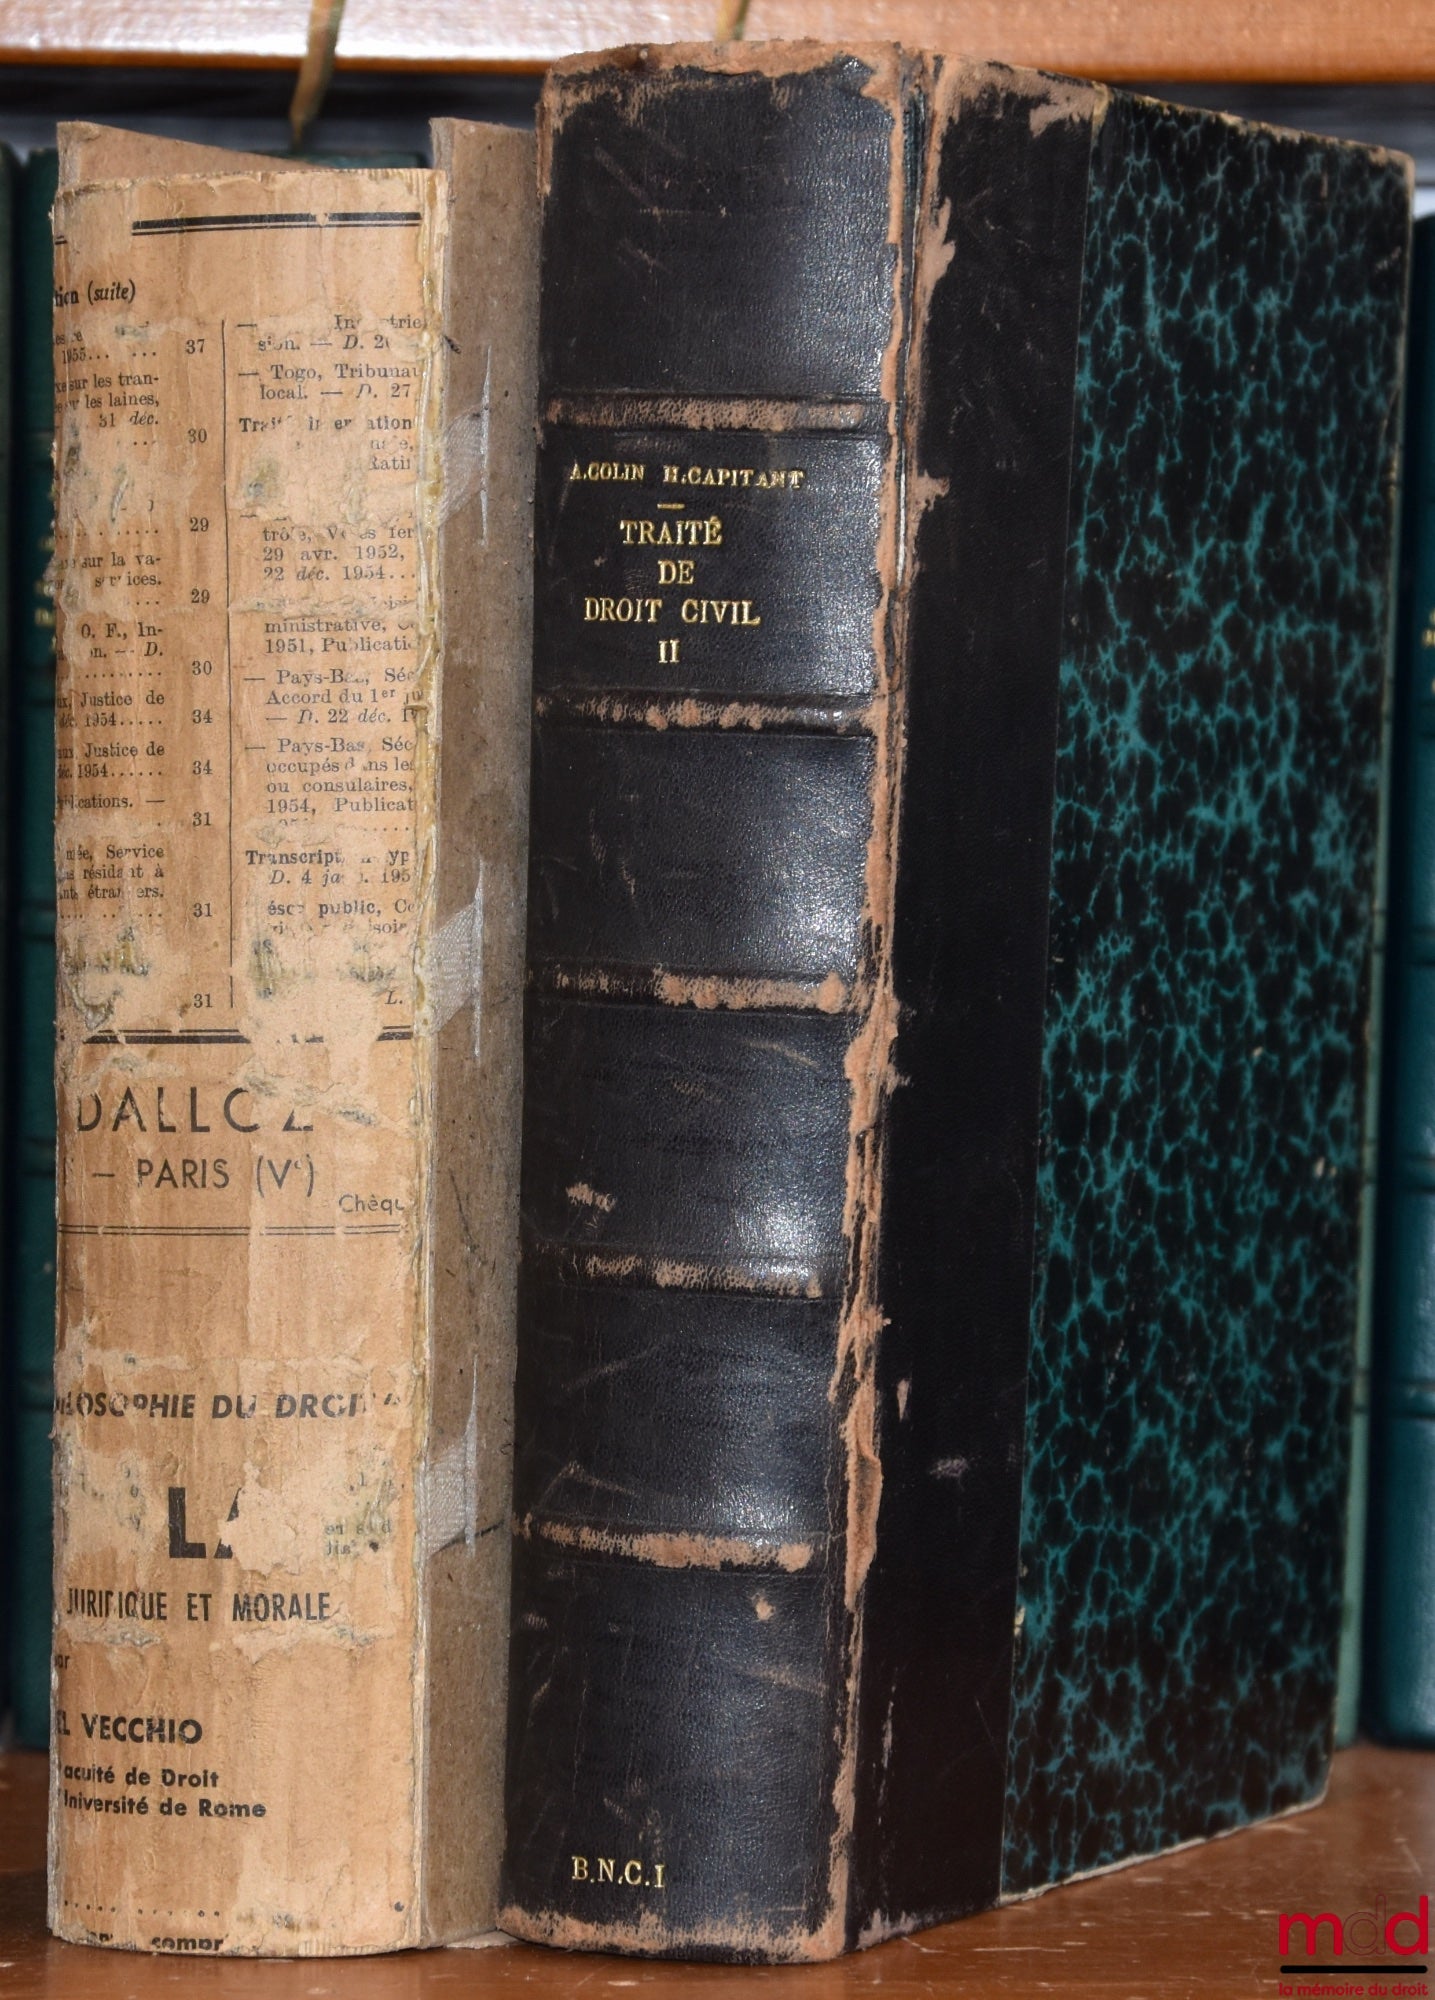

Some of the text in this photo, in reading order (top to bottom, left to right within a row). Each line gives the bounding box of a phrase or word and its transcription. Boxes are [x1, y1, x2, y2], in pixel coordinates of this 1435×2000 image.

[87, 278, 136, 306] (suite)
[184, 339, 206, 355] 37
[342, 334, 364, 350] D.
[92, 374, 112, 388] les
[118, 371, 160, 386] tran-
[270, 364, 322, 382] Togo,
[260, 384, 308, 400] local.
[391, 383, 411, 398] 27
[85, 394, 102, 408] les
[108, 393, 160, 408] laines,
[128, 410, 159, 426] déc.
[187, 428, 208, 444] 30
[570, 462, 646, 481] A.COLIN
[190, 516, 210, 532] 29
[82, 556, 104, 568] sur
[111, 552, 126, 566] la
[135, 554, 161, 566] va-
[262, 544, 404, 562] 29 avr. 1952,
[264, 566, 284, 581] 22
[296, 566, 330, 581] déc.
[658, 560, 695, 584] DE
[190, 588, 210, 604] 29
[584, 597, 762, 626] DROIT CIVIL
[264, 618, 386, 634] ministrative,
[144, 641, 164, 657] D.
[265, 638, 314, 654] 1951,
[658, 639, 681, 664] II
[191, 660, 212, 676] 30
[80, 691, 133, 708] Justice
[146, 690, 165, 705] de
[266, 688, 330, 705] Accord
[338, 688, 363, 704] du
[192, 708, 213, 725] 34
[328, 708, 349, 724] 22
[358, 708, 392, 724] déc.
[84, 742, 138, 758] Justice
[146, 741, 165, 756] de
[192, 760, 213, 776] 34
[266, 758, 340, 776] occupés
[266, 777, 413, 794] ou consulaires,
[266, 797, 414, 816] 1954, Publicat
[192, 812, 212, 827] 31
[106, 844, 164, 860] Service
[154, 864, 164, 878] à
[269, 869, 291, 884] D.
[301, 869, 312, 884] 4
[192, 902, 212, 918] 31
[319, 900, 382, 918] public,
[193, 994, 213, 1009] 31
[137, 1158, 230, 1190] PARIS
[211, 1394, 257, 1420] DU
[186, 1592, 213, 1622] ET
[232, 1590, 331, 1622] MORALE
[81, 1712, 204, 1746] VECCHIO
[125, 1766, 151, 1786] de
[161, 1768, 220, 1788] Droit
[159, 1795, 187, 1818] de
[199, 1799, 267, 1818] Rome
[572, 1856, 665, 1888] B.N.C.I
